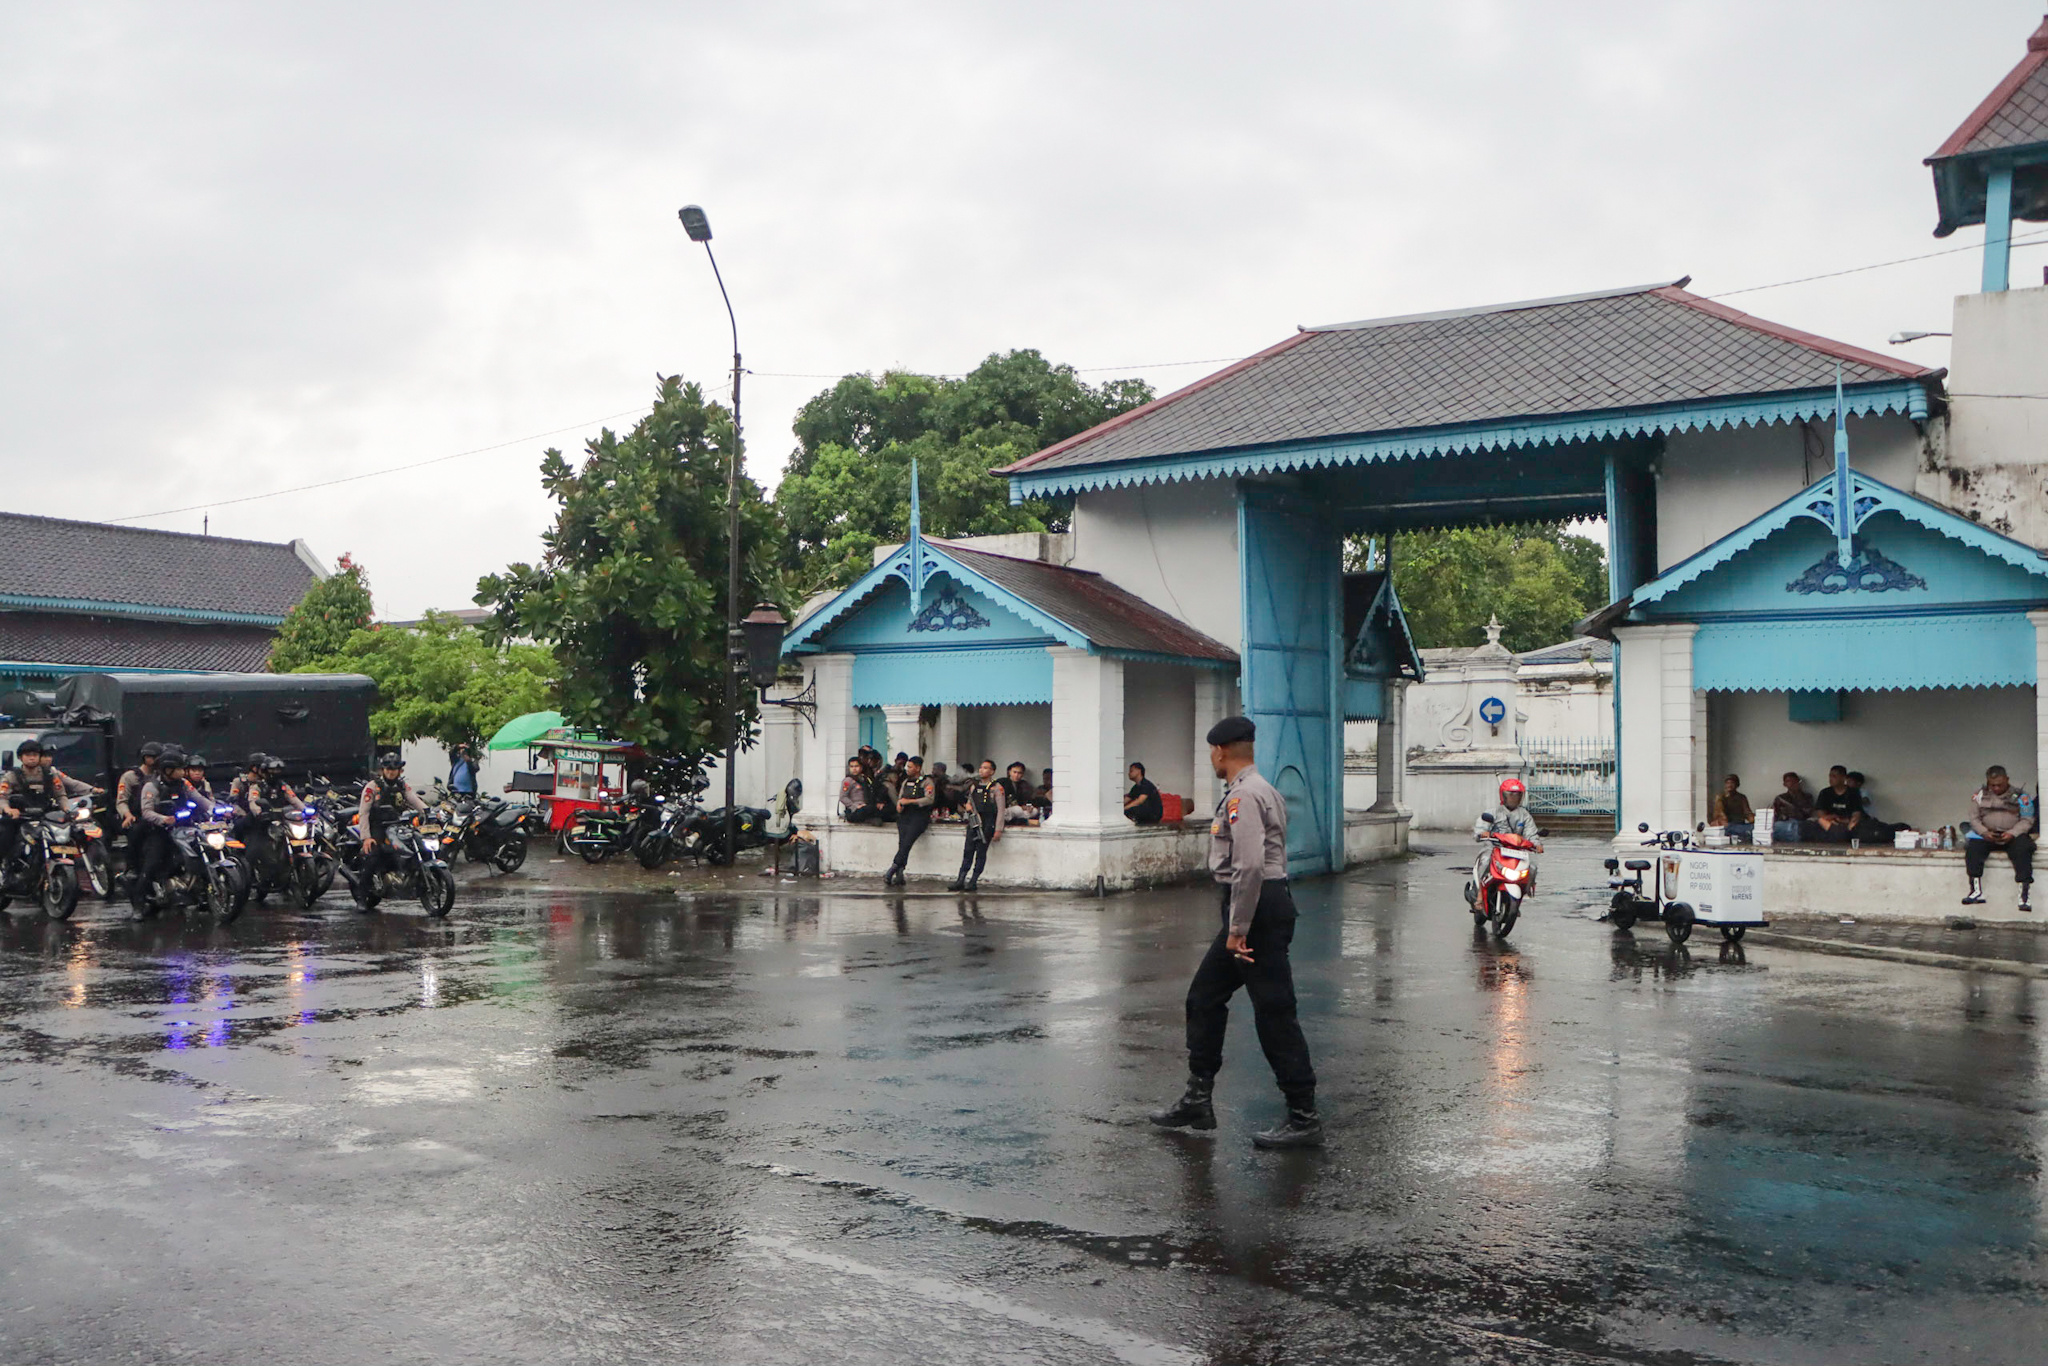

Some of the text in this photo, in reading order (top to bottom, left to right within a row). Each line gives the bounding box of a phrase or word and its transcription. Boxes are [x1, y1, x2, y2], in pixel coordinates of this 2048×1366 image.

[567, 749, 600, 760] BAKSO
[1689, 861, 1708, 870] NGOPI
[1689, 871, 1711, 880] CUMAN
[1689, 881, 1712, 891] RP 6000
